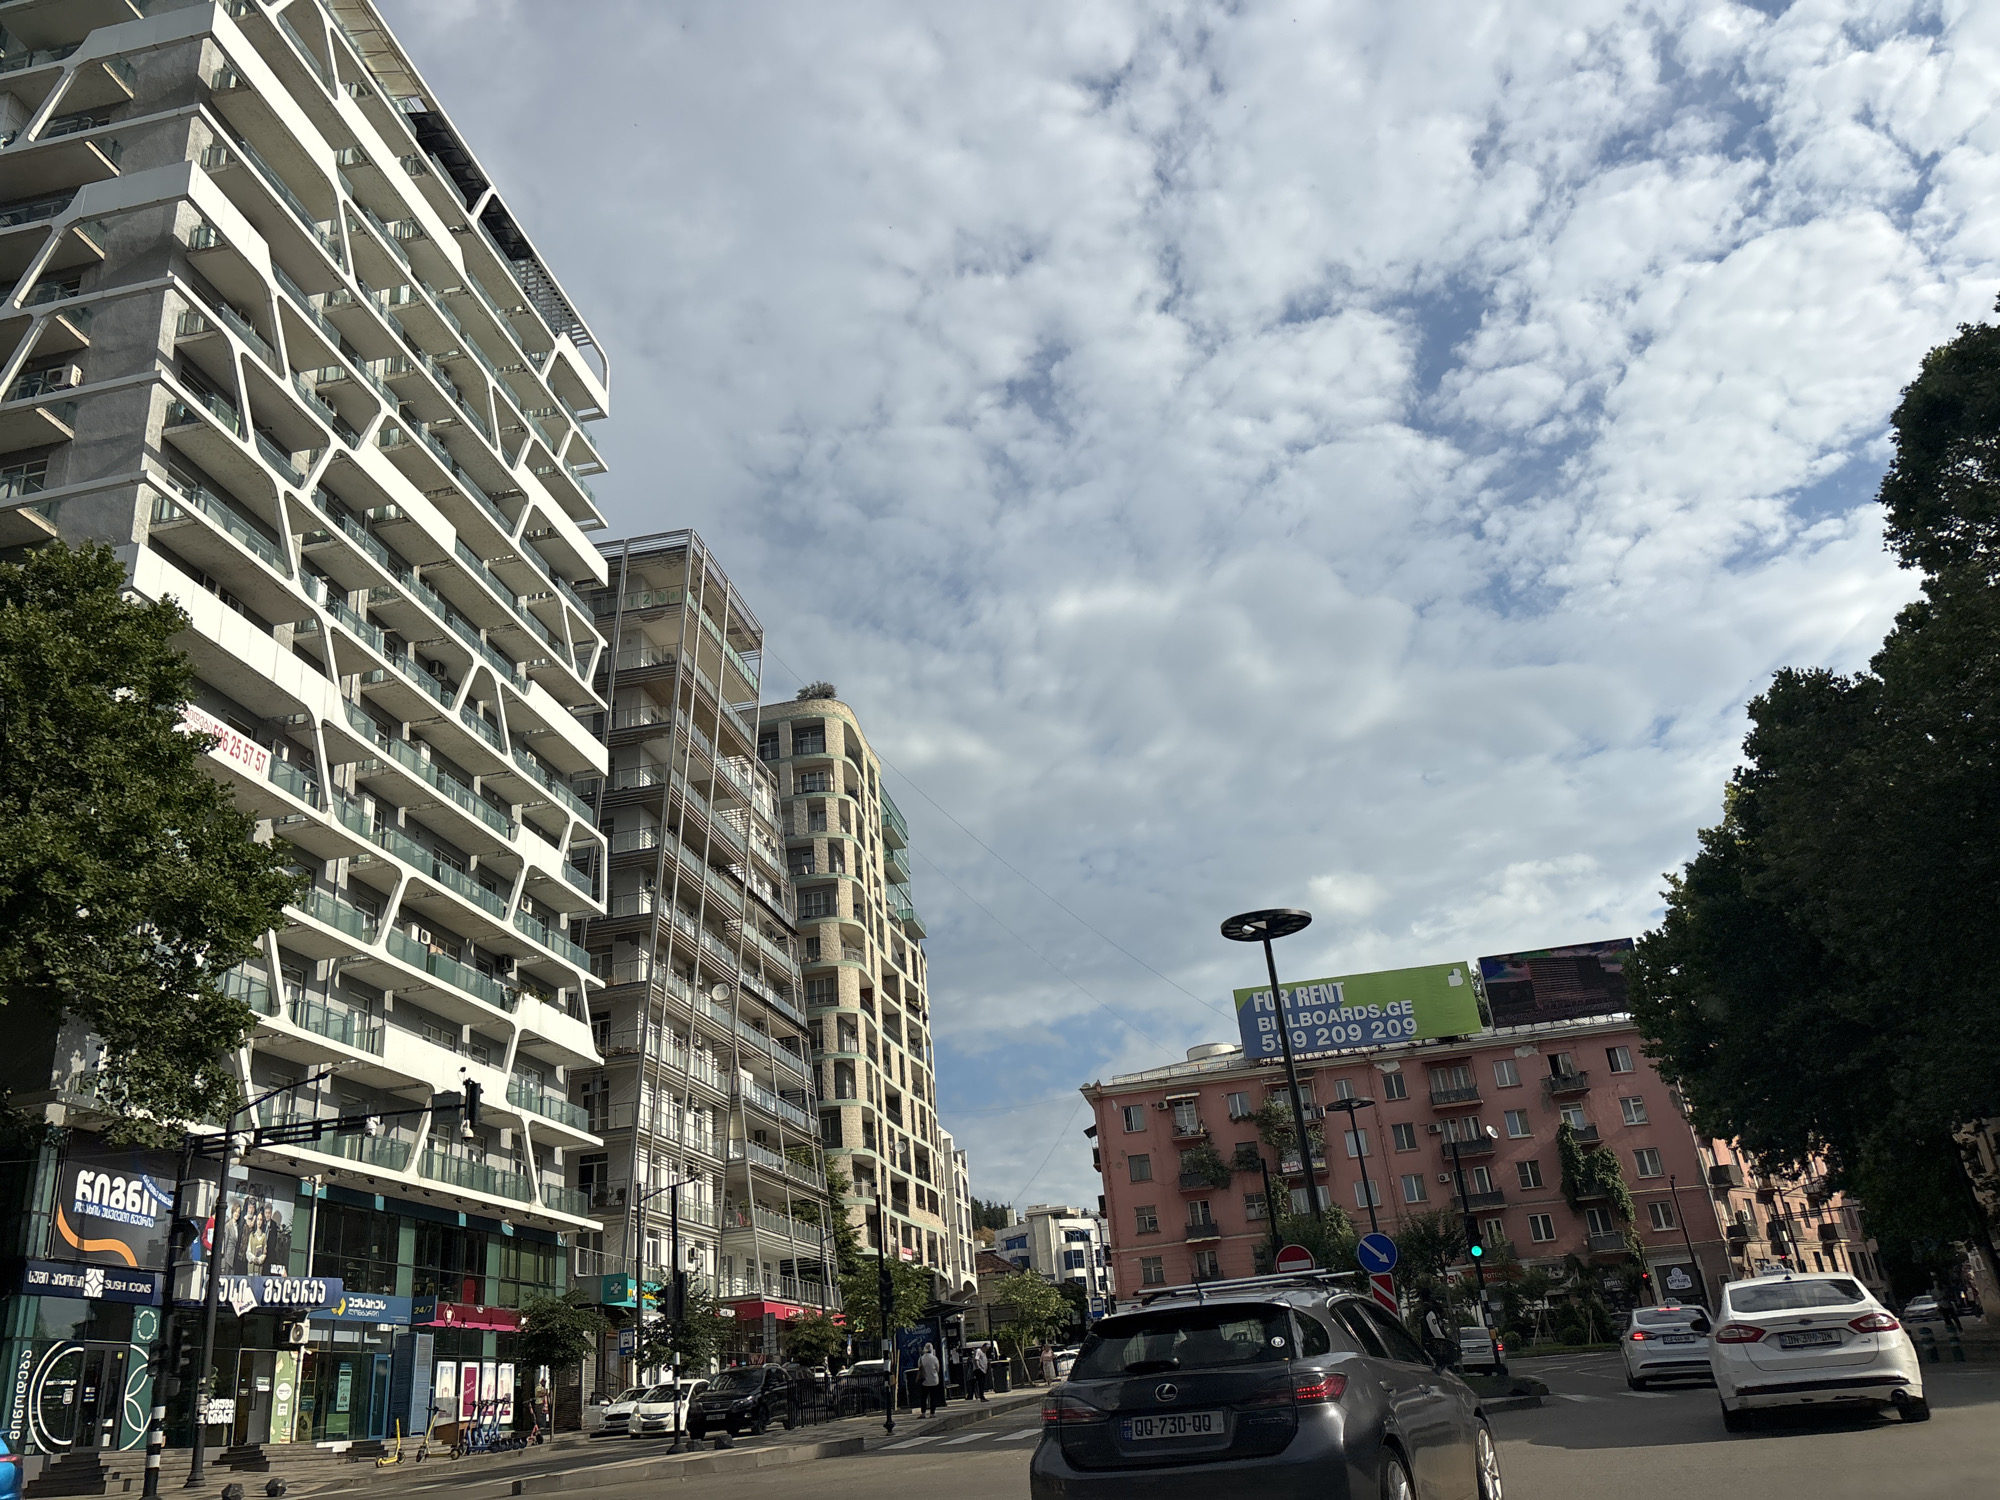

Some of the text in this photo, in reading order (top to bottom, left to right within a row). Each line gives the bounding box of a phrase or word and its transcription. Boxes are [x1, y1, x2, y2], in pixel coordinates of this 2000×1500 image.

[229, 735, 242, 760] 25
[242, 743, 255, 766] 57
[255, 751, 267, 774] 57
[1253, 981, 1345, 1013] FOR RENT
[1257, 1000, 1415, 1032] BILBOARDS.GE
[1315, 1024, 1363, 1046] 209
[1370, 1017, 1418, 1040] 209
[104, 1280, 152, 1294] SUSHI ICONS
[263, 1277, 327, 1304] გალერეა
[348, 1297, 387, 1310] ექსპრეს
[413, 1305, 433, 1315] 24/7
[9, 1349, 32, 1440] მიწოდება
[1134, 1414, 1212, 1437] QQ-730-QQ
